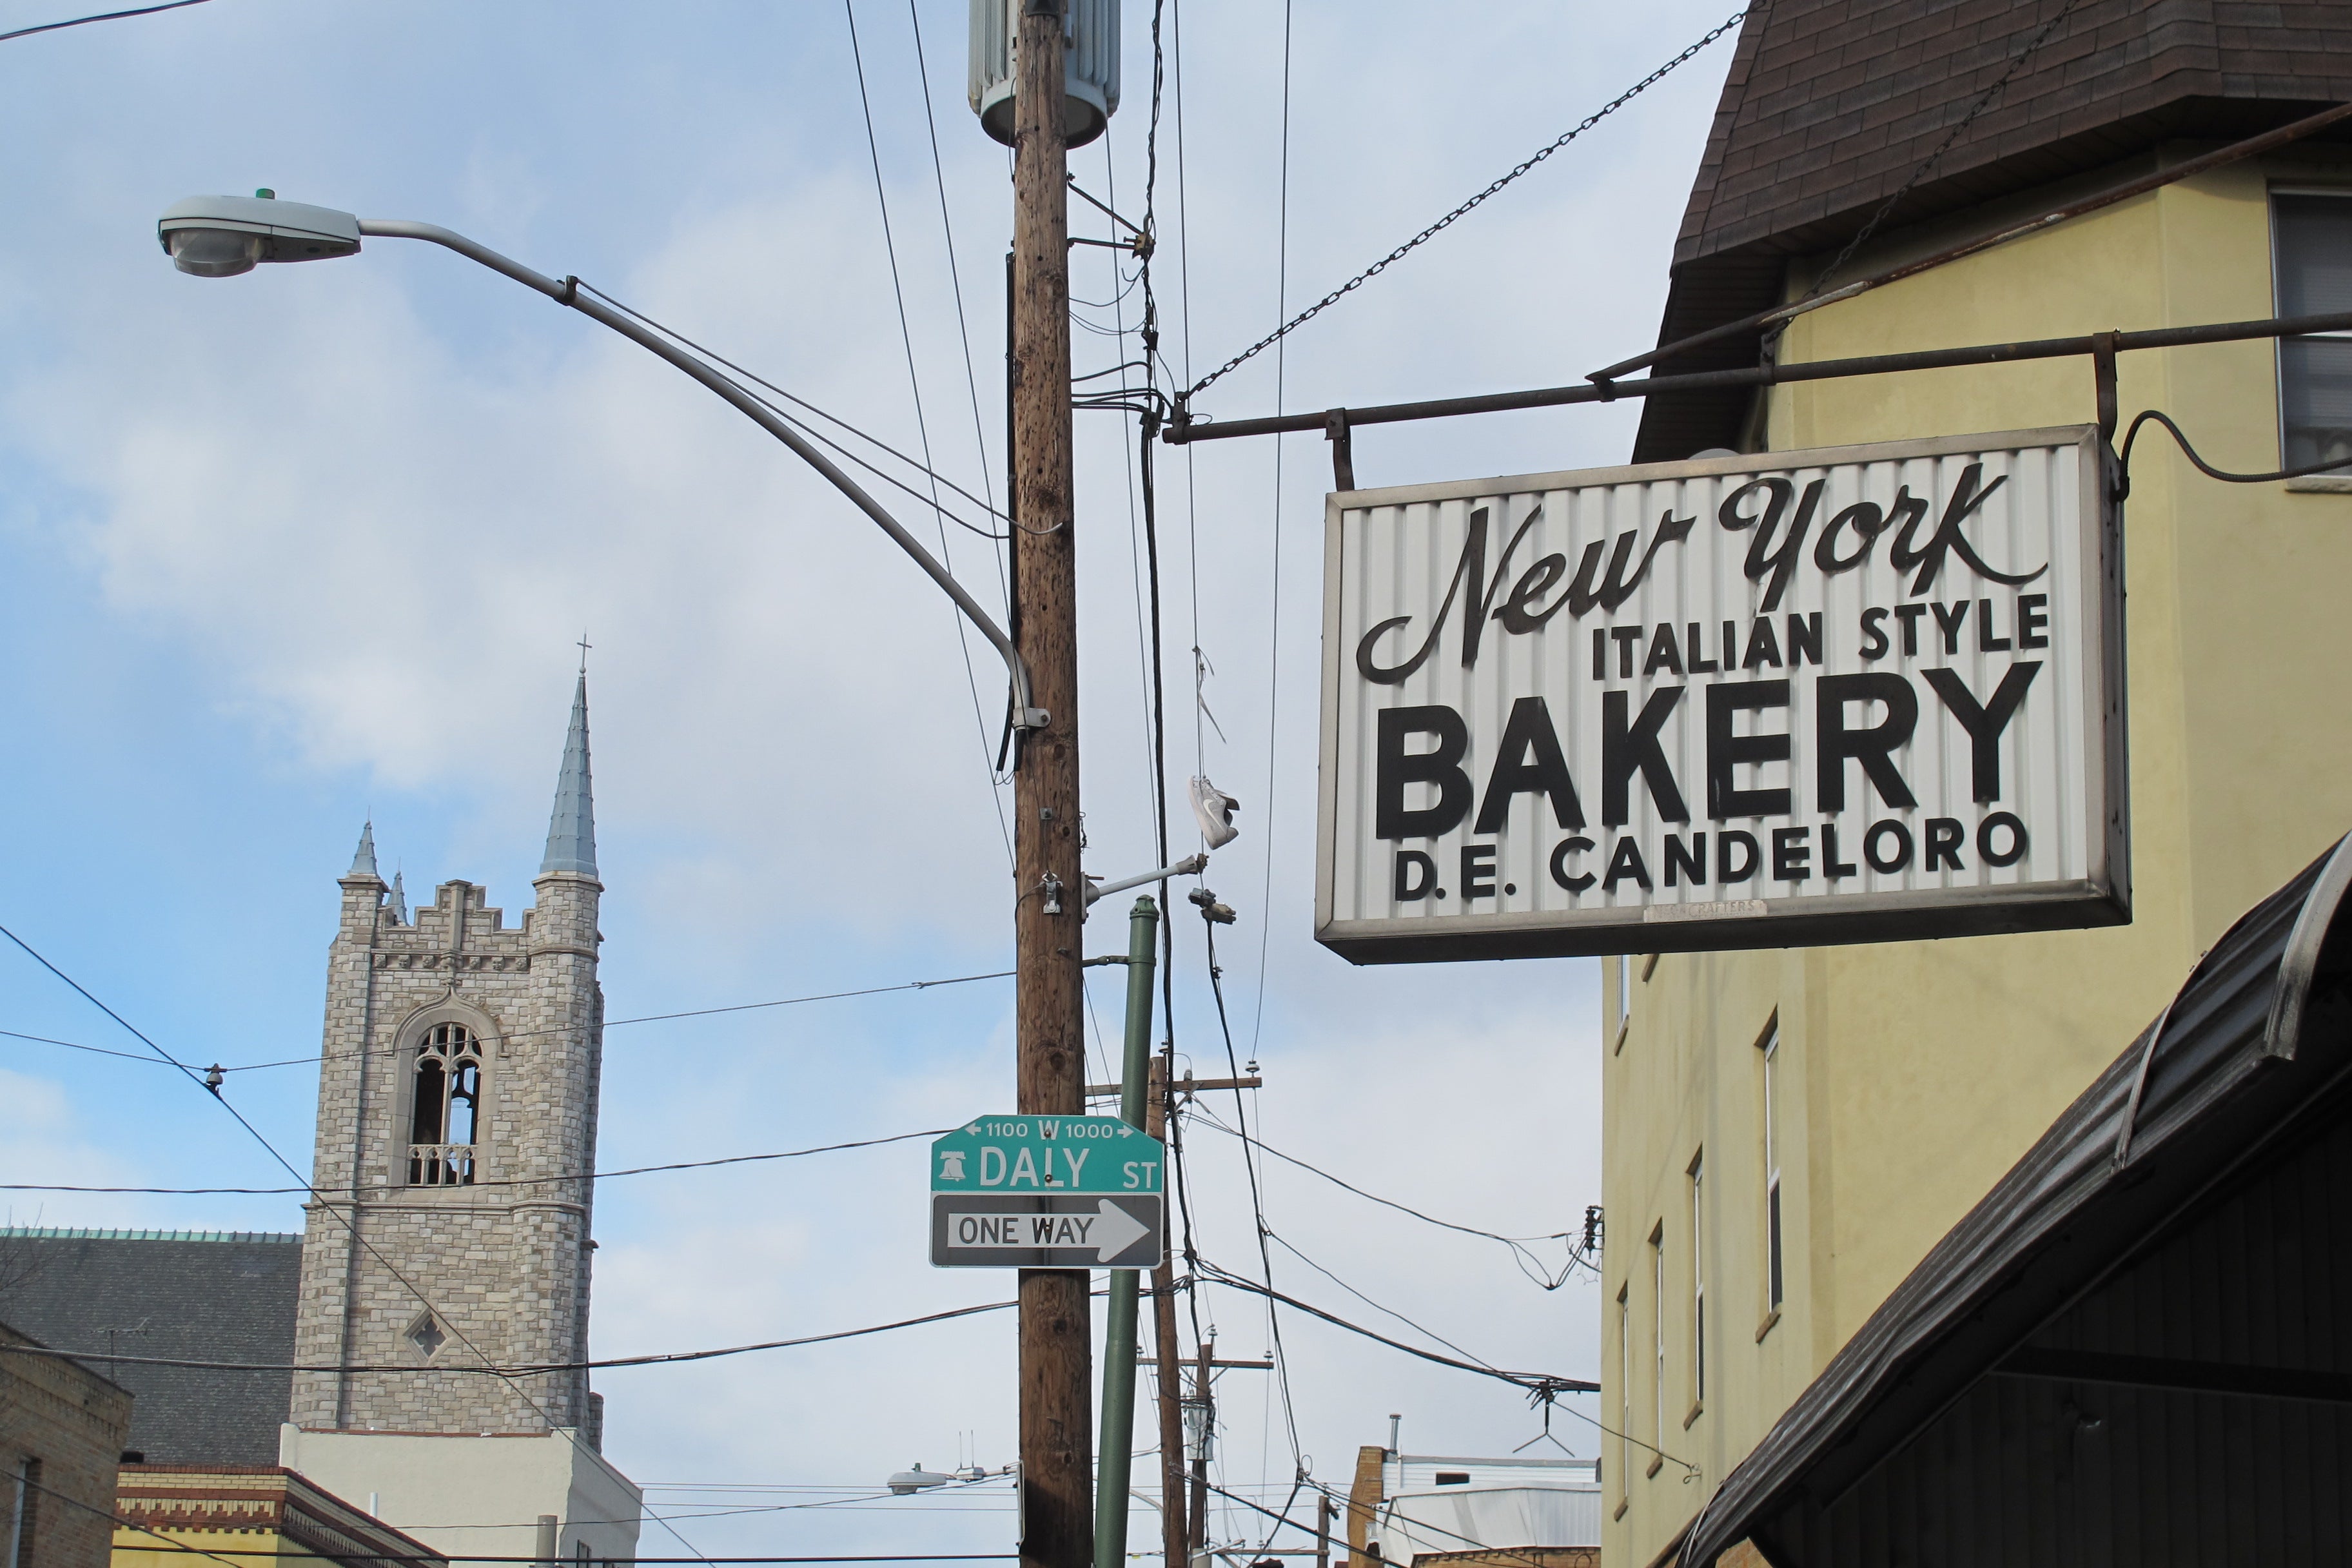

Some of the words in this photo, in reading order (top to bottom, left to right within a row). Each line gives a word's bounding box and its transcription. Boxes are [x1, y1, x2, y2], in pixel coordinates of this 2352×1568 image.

[1357, 504, 1696, 685] New
[1719, 462, 2048, 612] York
[1592, 612, 1823, 680] ITALIAN
[1859, 593, 2048, 660] STYLE
[1376, 661, 2043, 839] BAKERY
[1395, 844, 1516, 901] D.E.
[1549, 811, 2029, 892] CANDELORO
[979, 1146, 1090, 1188] DALY
[1123, 1161, 1157, 1189] ST
[986, 1122, 1028, 1137] 1100
[1038, 1120, 1060, 1141] W
[1066, 1124, 1113, 1139] 1000
[959, 1217, 1019, 1244] ONE
[1032, 1217, 1094, 1244] WAY
